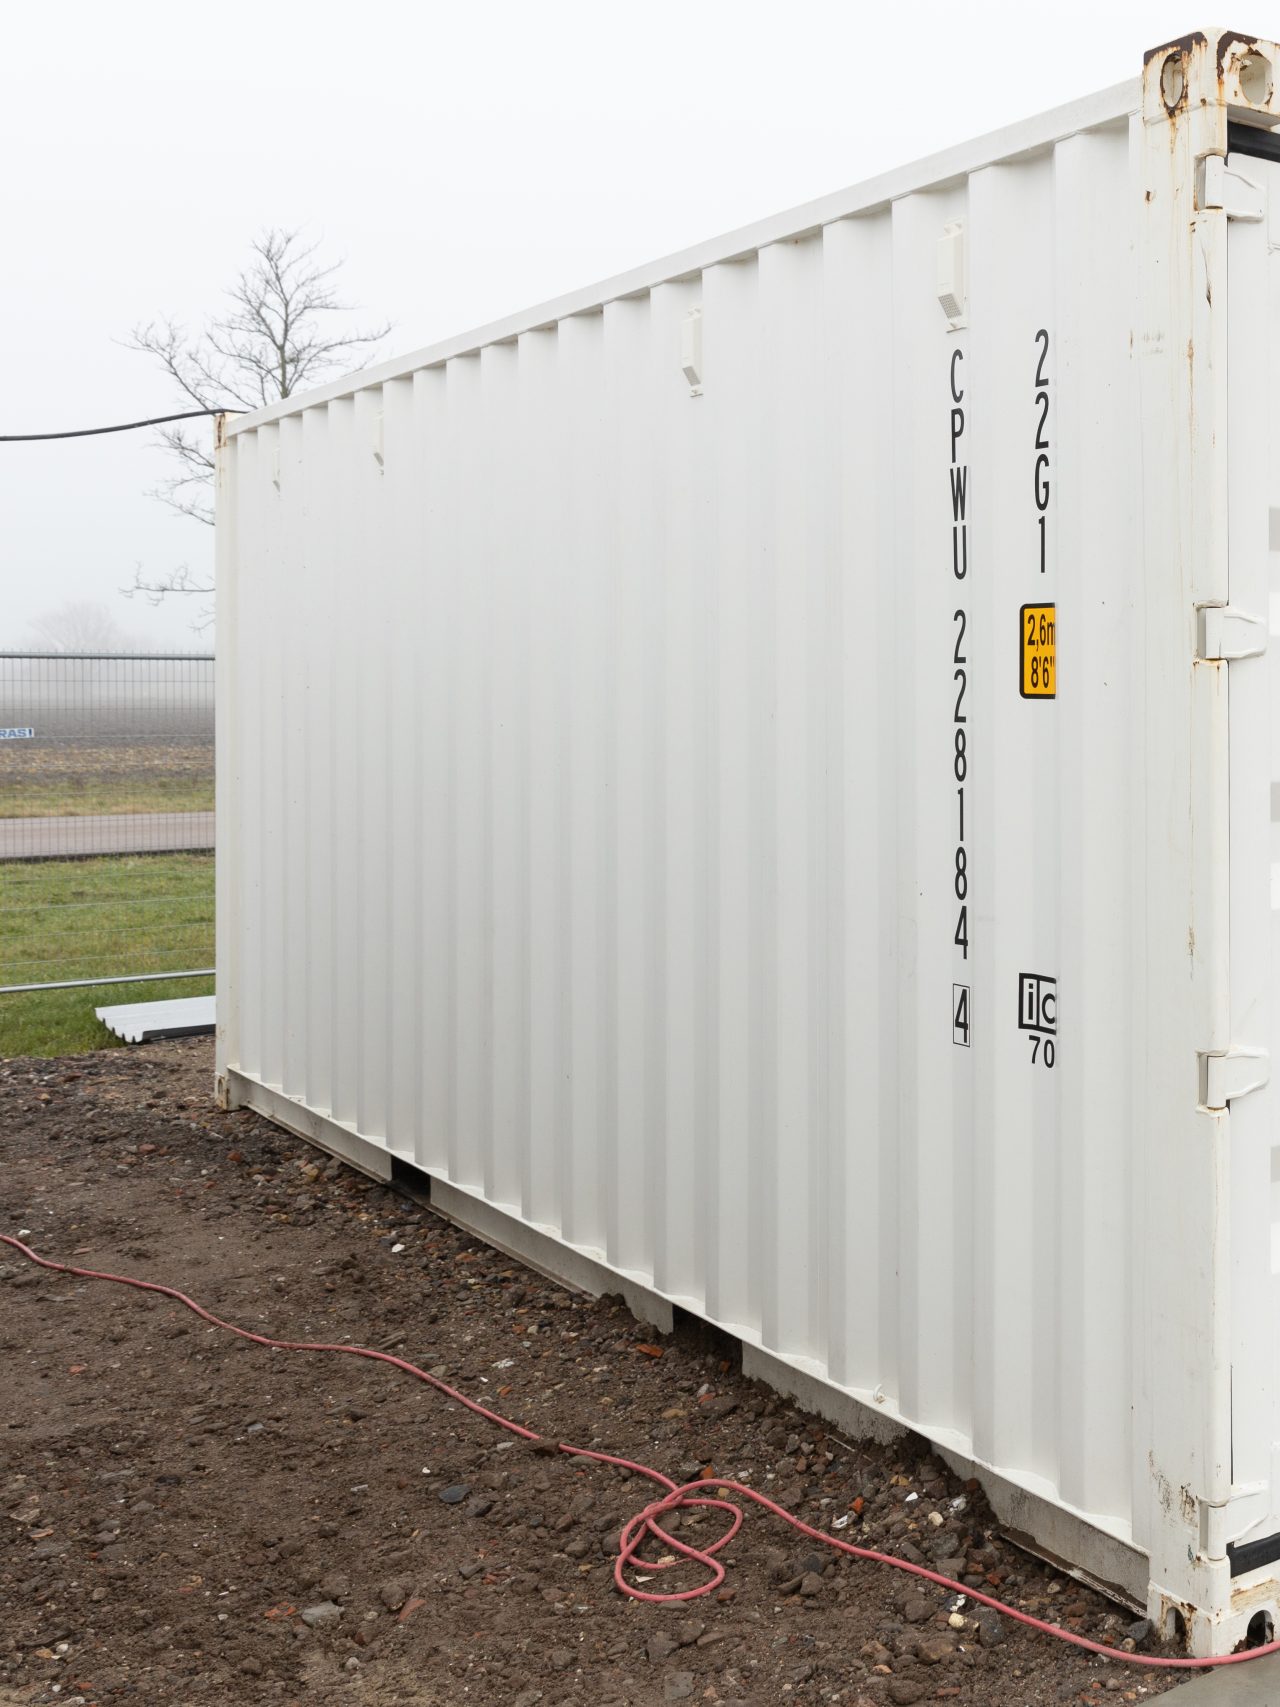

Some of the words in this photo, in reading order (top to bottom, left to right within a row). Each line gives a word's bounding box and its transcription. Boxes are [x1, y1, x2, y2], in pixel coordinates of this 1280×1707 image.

[950, 349, 967, 580] CPWU
[1034, 329, 1050, 573] 22G1
[953, 609, 968, 960] 228184
[955, 988, 968, 1044] 4
[1029, 1034, 1055, 1068] 70
